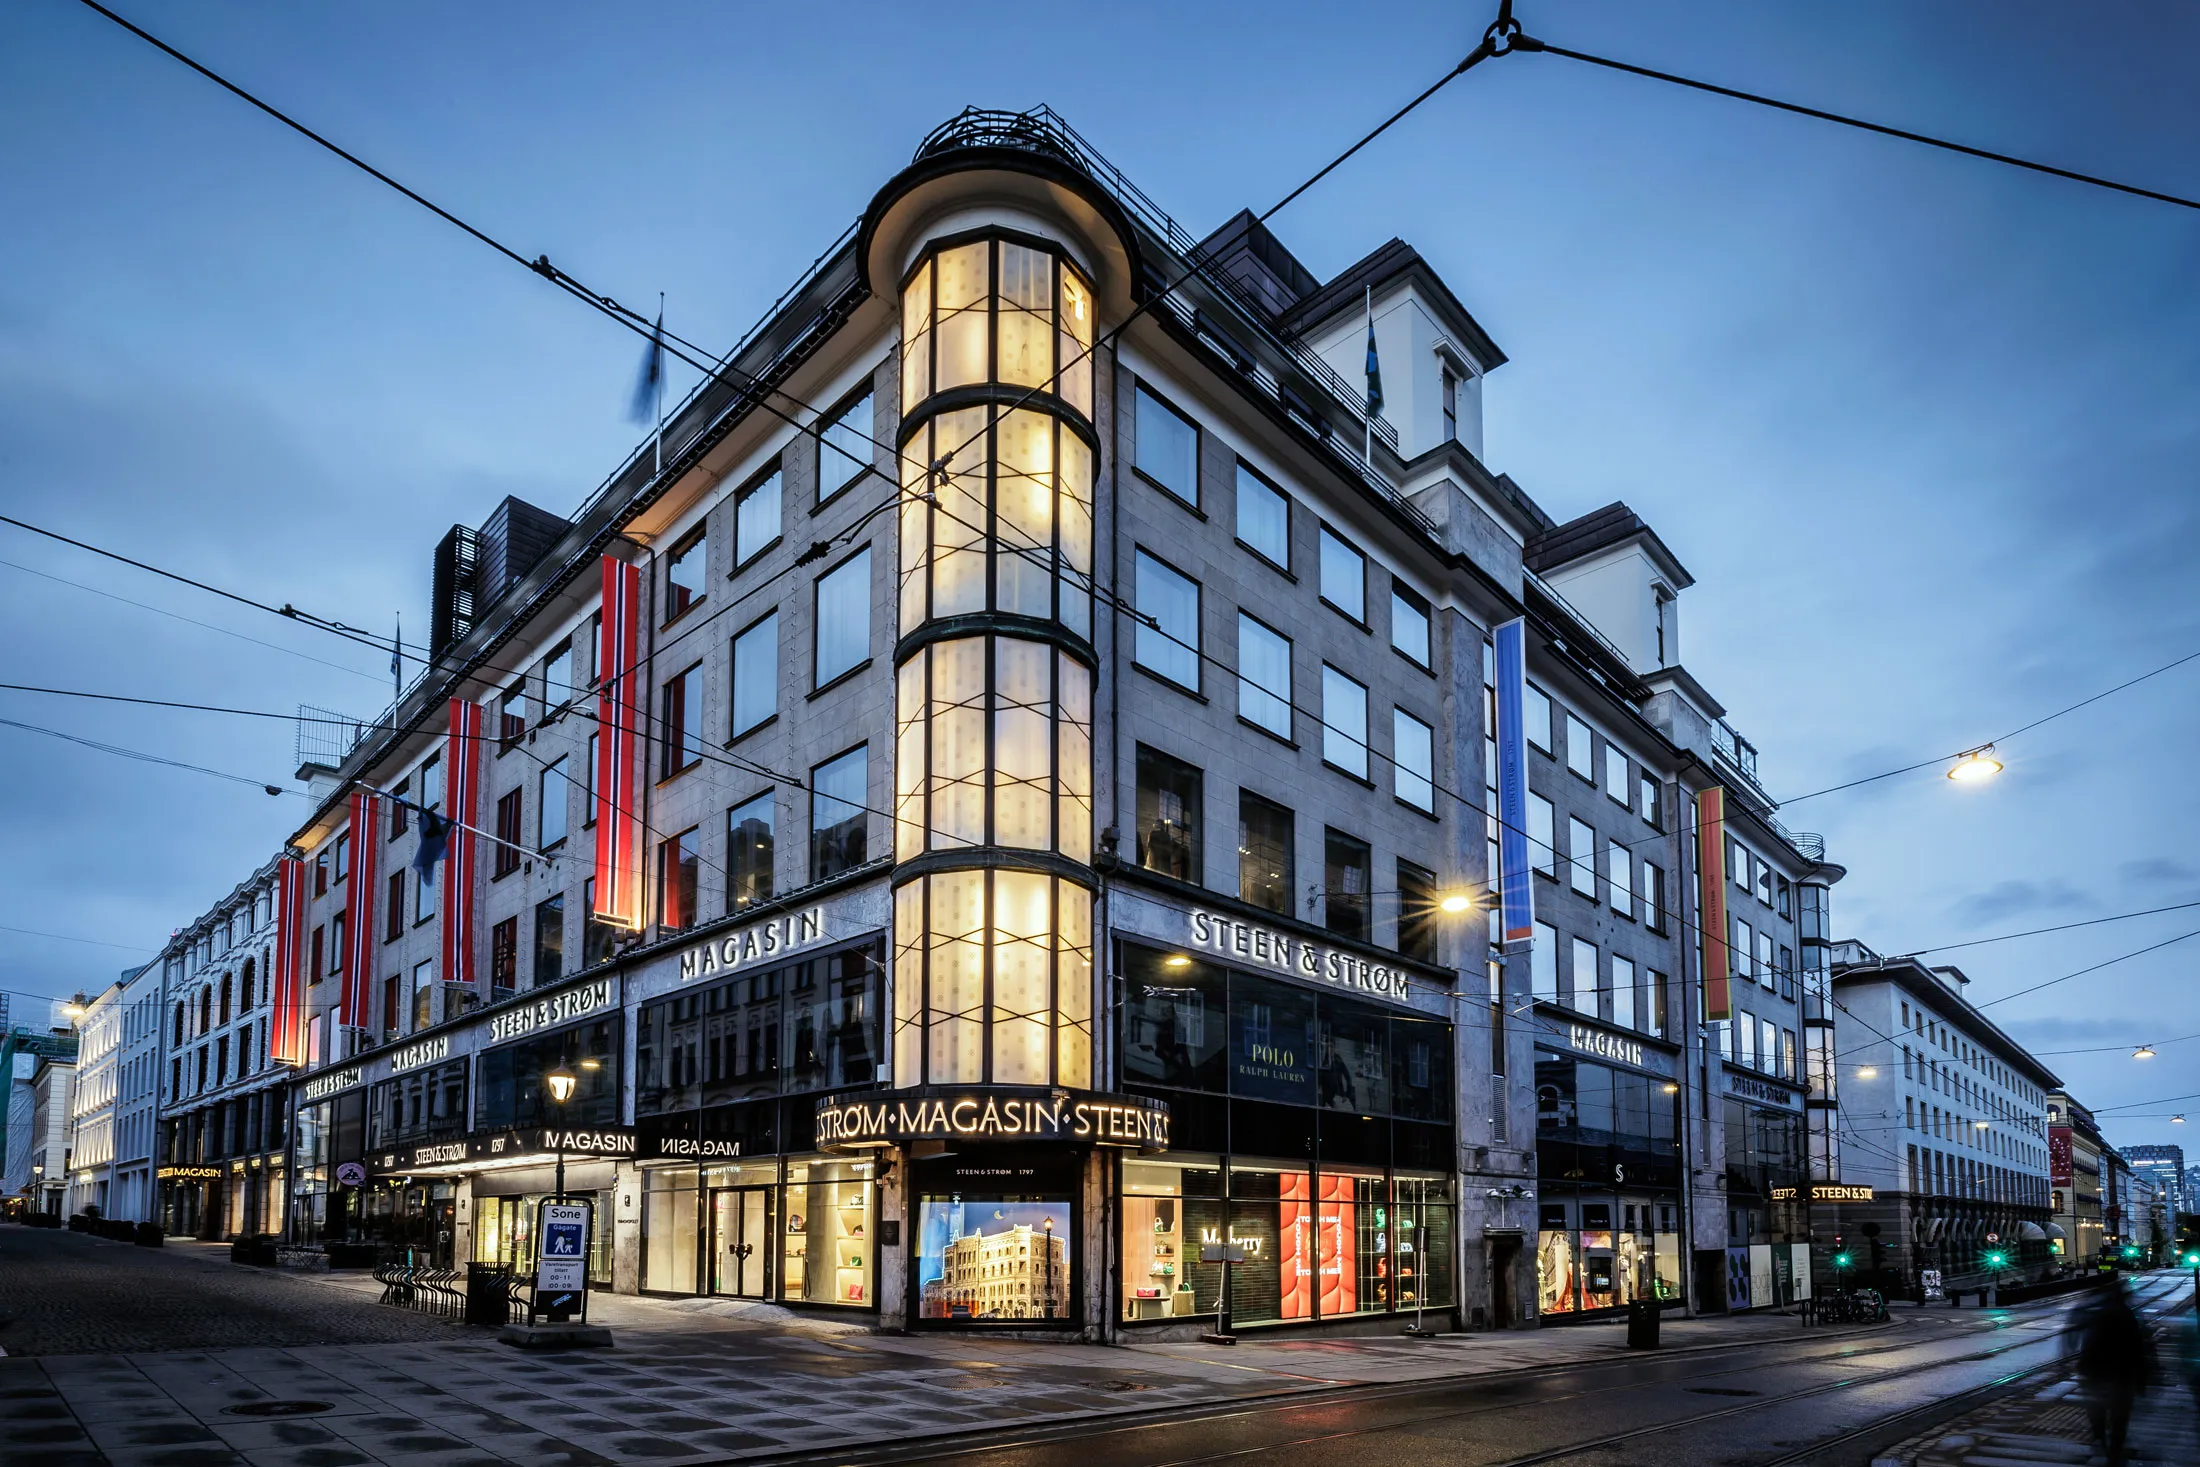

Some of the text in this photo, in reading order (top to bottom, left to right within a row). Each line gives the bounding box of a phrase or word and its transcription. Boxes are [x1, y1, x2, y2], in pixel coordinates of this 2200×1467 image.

[680, 907, 821, 980] MAGASIN
[1194, 911, 1410, 999] STEEN & STRØM
[489, 980, 611, 1041] STEEN & STRØM
[391, 1036, 449, 1073] MAGASIN
[1570, 1024, 1643, 1066] MAGASIN
[1252, 1043, 1294, 1069] POLO
[1239, 1064, 1305, 1083] RALPH LAUREN
[819, 1103, 887, 1142] STRØM
[899, 1099, 1060, 1134] MAGASIN
[1074, 1103, 1151, 1140] STEEN
[491, 1138, 505, 1153] 1797
[545, 1131, 636, 1152] MAGASIN
[174, 1167, 222, 1178] MAGASIN
[1018, 1168, 1034, 1176] 1797
[1615, 1163, 1624, 1182] S
[551, 1208, 581, 1219] Sone
[553, 1224, 577, 1232] Gågate
